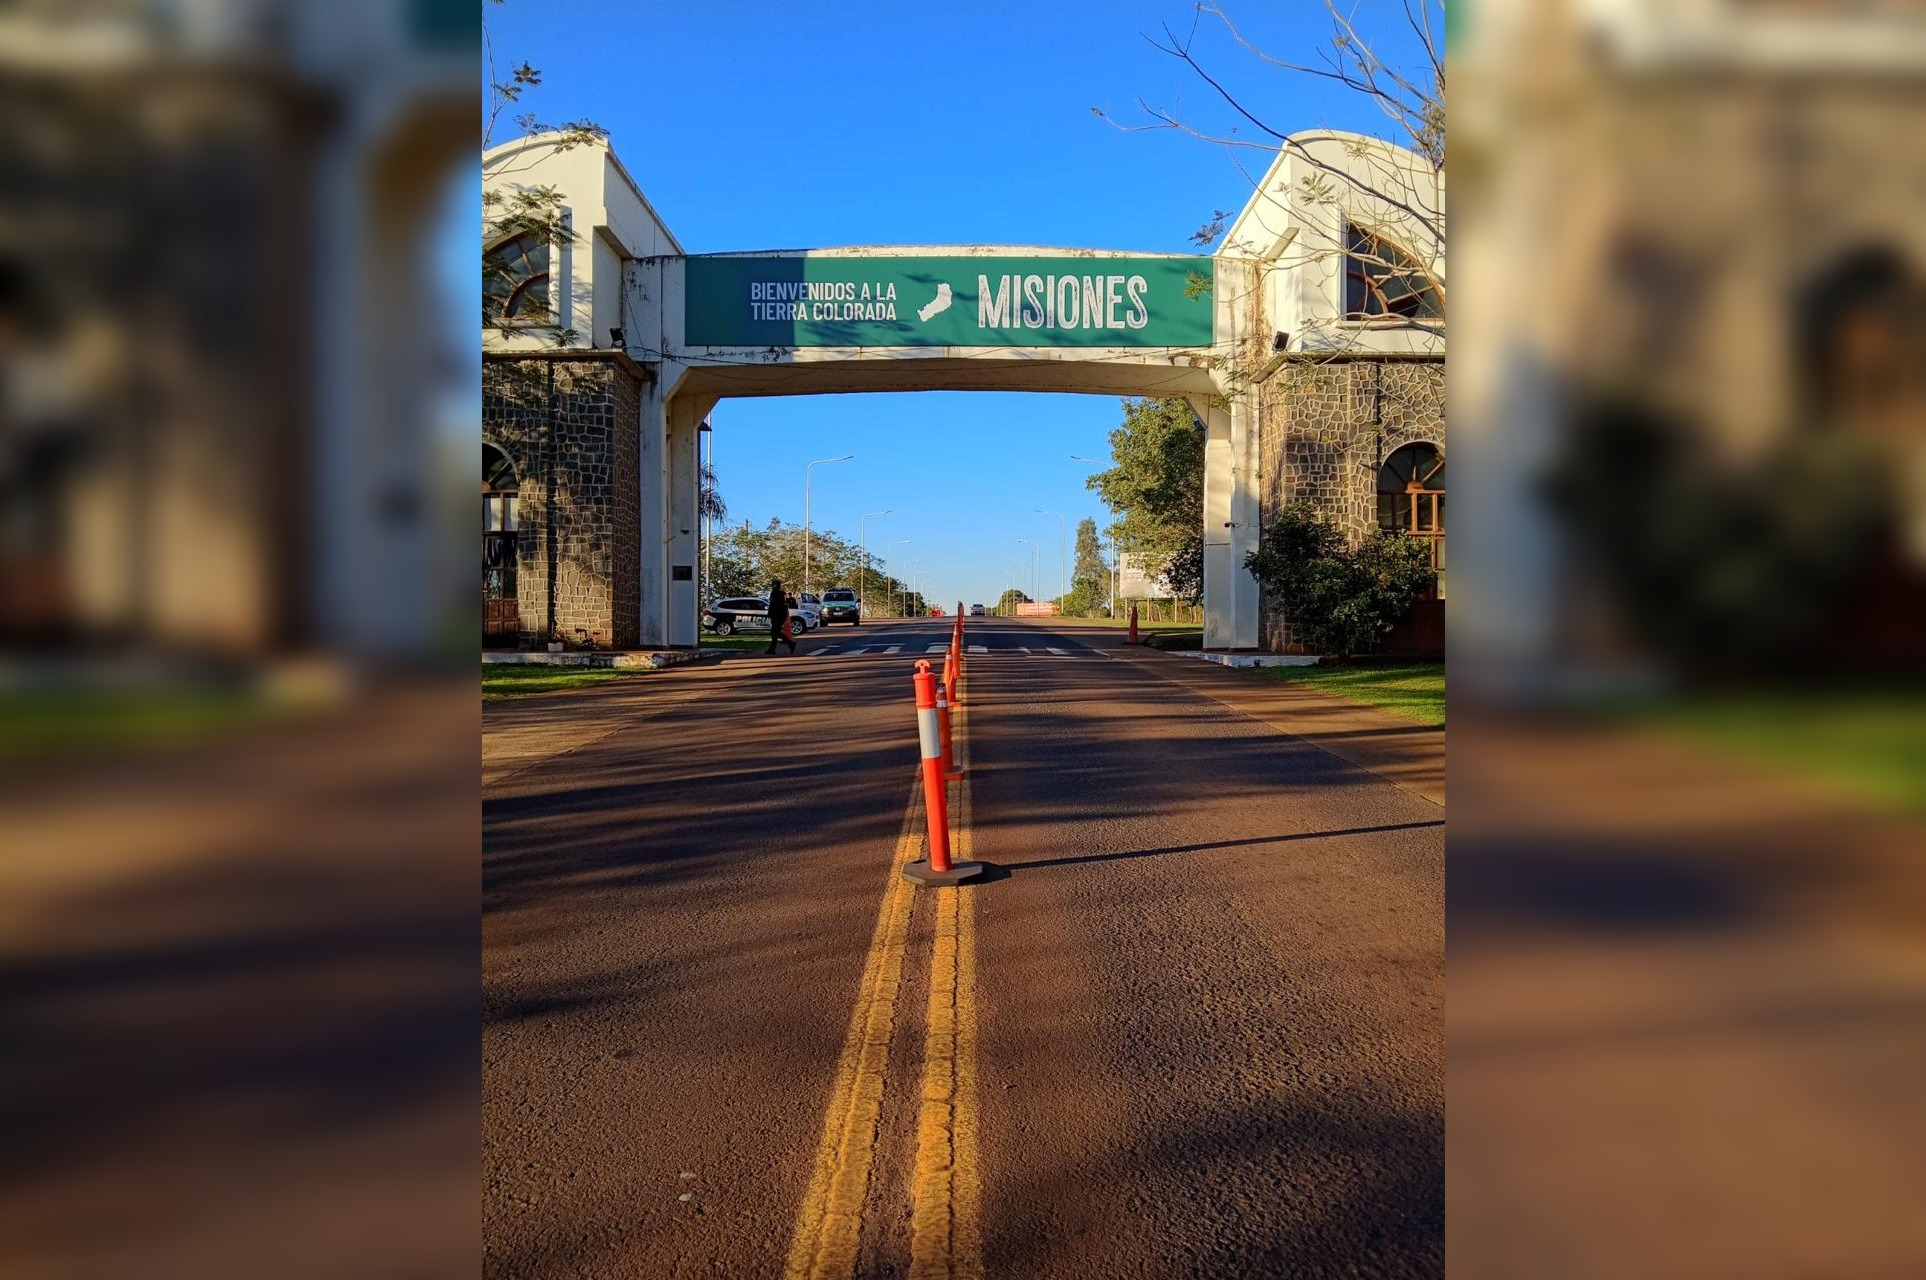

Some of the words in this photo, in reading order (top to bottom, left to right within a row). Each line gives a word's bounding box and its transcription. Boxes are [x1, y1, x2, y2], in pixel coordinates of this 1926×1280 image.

[751, 282, 855, 300] BIENVENIDOS
[860, 282, 872, 300] A
[876, 282, 897, 300] LA
[978, 274, 1148, 329] MISIONES
[751, 302, 808, 321] TIERRA
[813, 302, 897, 321] COLORADA
